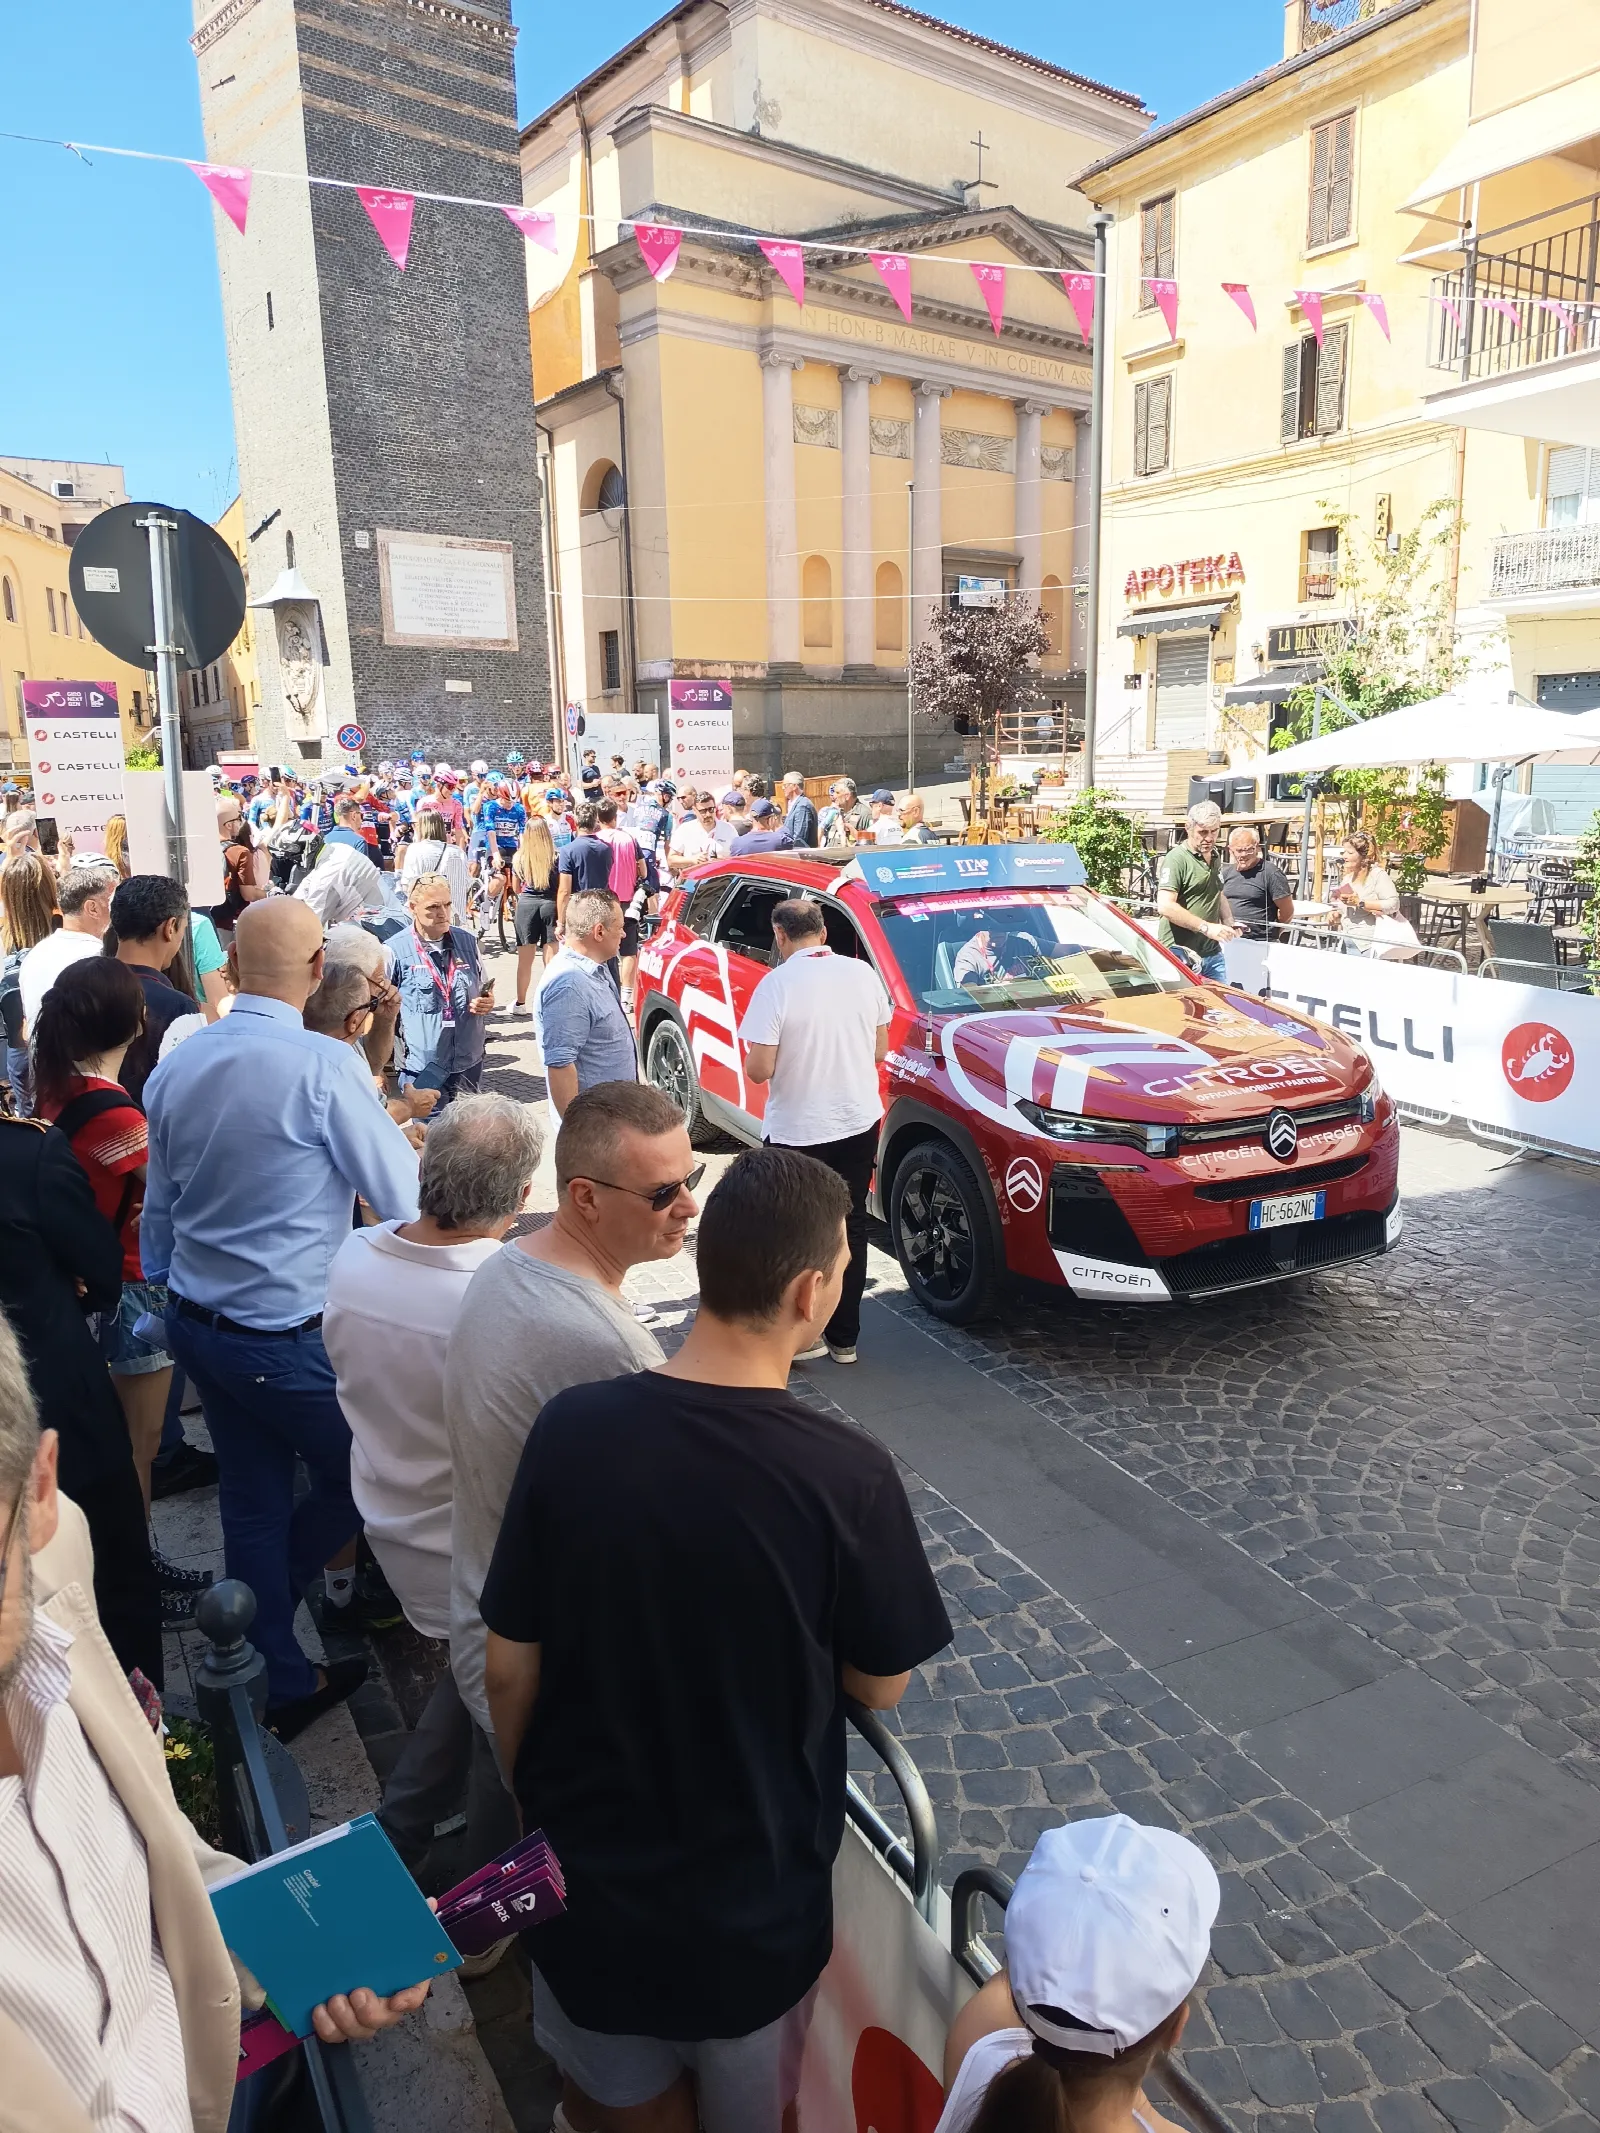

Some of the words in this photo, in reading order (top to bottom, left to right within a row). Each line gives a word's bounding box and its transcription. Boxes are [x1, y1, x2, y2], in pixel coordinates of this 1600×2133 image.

[893, 327, 956, 359] MARIAE
[1007, 354, 1065, 382] COELVM
[1122, 551, 1245, 597] APOTEKA
[1277, 630, 1291, 652] LA
[53, 731, 117, 739] CASTELLI
[57, 762, 120, 771] CASTELLI
[60, 793, 124, 802] CASTELLI
[1143, 1056, 1346, 1097] CITROËN
[1196, 1088, 1242, 1102] OFFICIAL
[1242, 1080, 1286, 1096] MOBILITY
[1284, 1075, 1329, 1088] PARTNER
[1182, 1145, 1265, 1167] CITROËN
[1299, 1123, 1364, 1149] CITROËN
[1072, 1266, 1152, 1287] CITROËN
[491, 1899, 511, 1923] 2026
